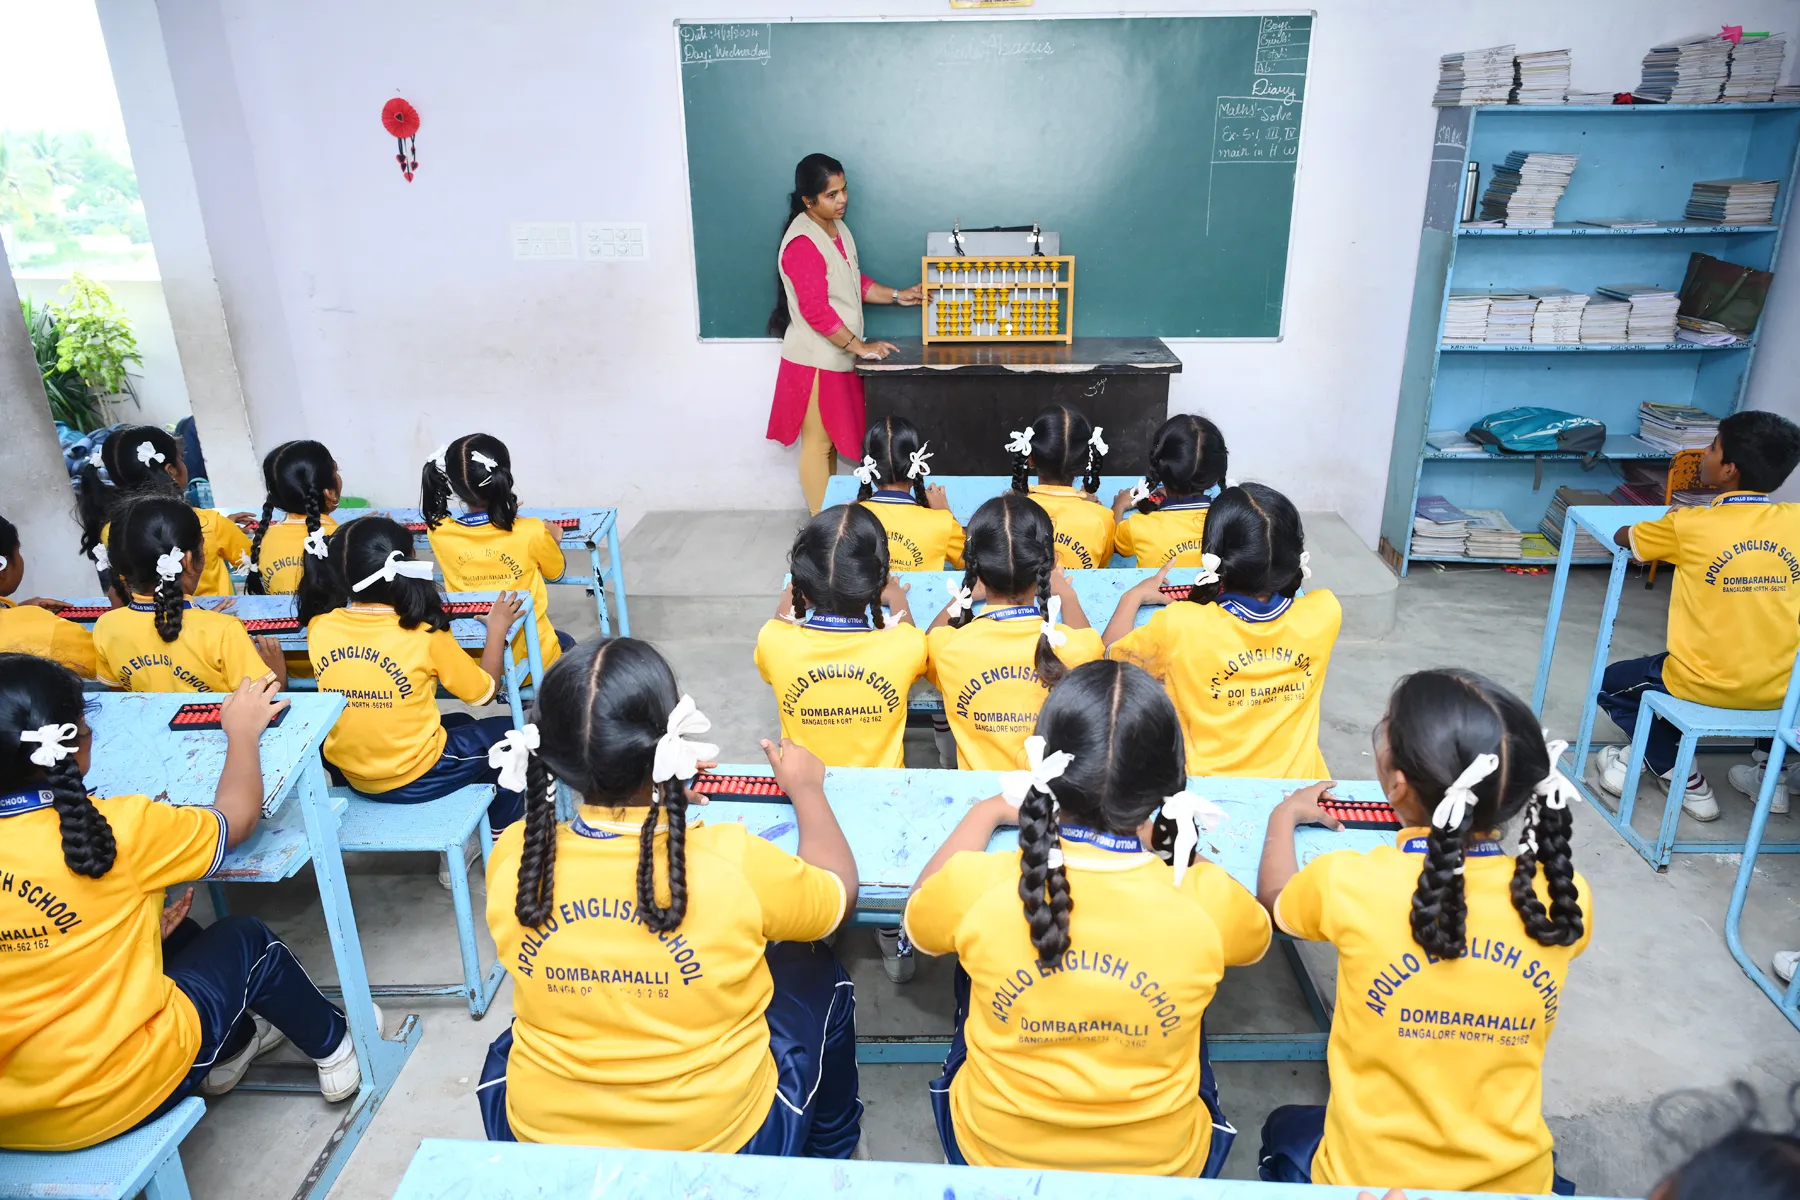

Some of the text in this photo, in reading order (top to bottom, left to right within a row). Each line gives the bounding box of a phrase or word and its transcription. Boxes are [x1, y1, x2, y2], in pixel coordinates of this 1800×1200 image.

[715, 44, 769, 66] Wednesday
[1252, 78, 1296, 106] Diary
[1260, 105, 1292, 121] Solve
[1254, 143, 1263, 156] in
[886, 530, 923, 567] LISH SCHOOL
[1071, 541, 1093, 570] SCHOO
[1176, 539, 1201, 553] ENGLI
[272, 555, 304, 571] ENGLIS
[499, 552, 524, 580] SCHOOL
[1704, 539, 1800, 586] APOLLO ENGLISH SCHOOL
[1723, 575, 1787, 585] DOMBARAHALLI
[1238, 647, 1293, 667] ENGLISH
[173, 665, 214, 693] SCHOO
[330, 645, 381, 664] ENGLISH
[379, 656, 414, 700] SCHOOL
[782, 663, 901, 717] APOLLO ENGLISH SCHOOL
[956, 665, 1041, 719] APOLLO ENGLISH
[351, 701, 370, 709] NORTH
[800, 705, 883, 717] DOMBARAHALLI
[801, 717, 836, 726] BANGALORE
[836, 717, 853, 725] NORT
[973, 711, 1040, 723] DOMBARAHA
[974, 723, 1031, 733] BANGALORE NORTH
[0, 795, 28, 807] CHOOL
[1061, 827, 1084, 839] SCHOOL
[1116, 840, 1138, 850] APOLLO
[18, 879, 83, 935] SCHOOL
[34, 938, 50, 950] 162
[517, 897, 704, 986] APOLLO ENGLISH CHOOL
[545, 966, 669, 985] DOMBARAHALLI
[1365, 952, 1421, 1018] APOLLO
[1425, 937, 1523, 969] LISH
[992, 969, 1034, 1025] APOLLO
[1129, 970, 1182, 1038] SCHOOL
[1021, 1016, 1149, 1037] DOMBARAHALLI
[1400, 1007, 1537, 1031] DOMBARAHALLI
[1397, 1026, 1457, 1040] BANGALORE
[1459, 1030, 1494, 1045] NORTH
